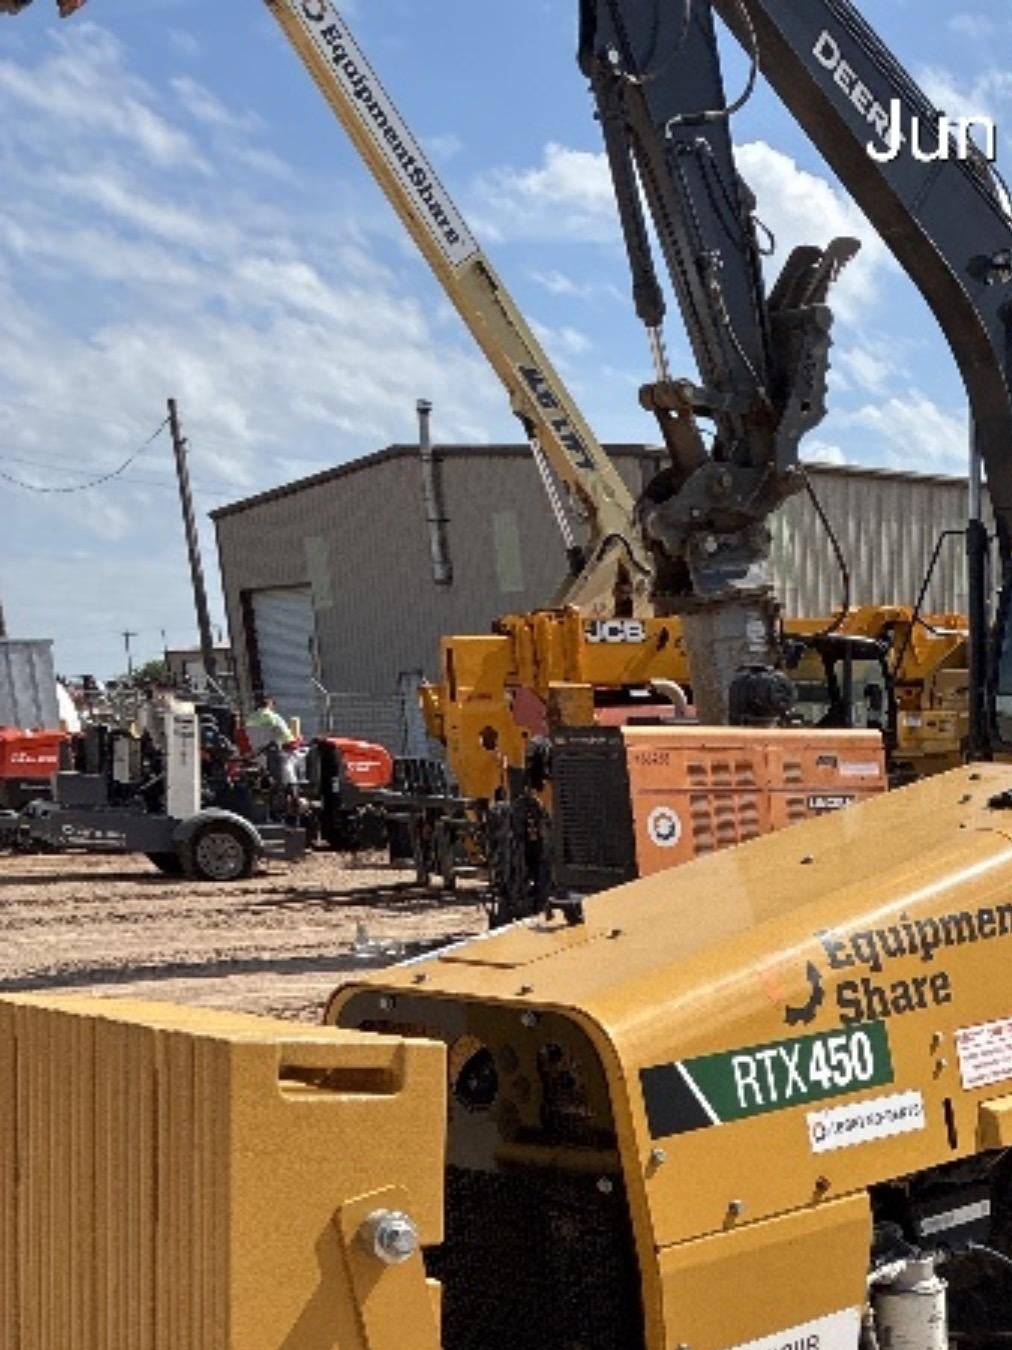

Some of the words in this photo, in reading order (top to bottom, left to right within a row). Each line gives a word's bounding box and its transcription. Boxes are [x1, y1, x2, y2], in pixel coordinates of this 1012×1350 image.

[320, 24, 460, 246] EquipmentShare
[585, 619, 646, 643] JCB
[836, 971, 952, 1024] Share
